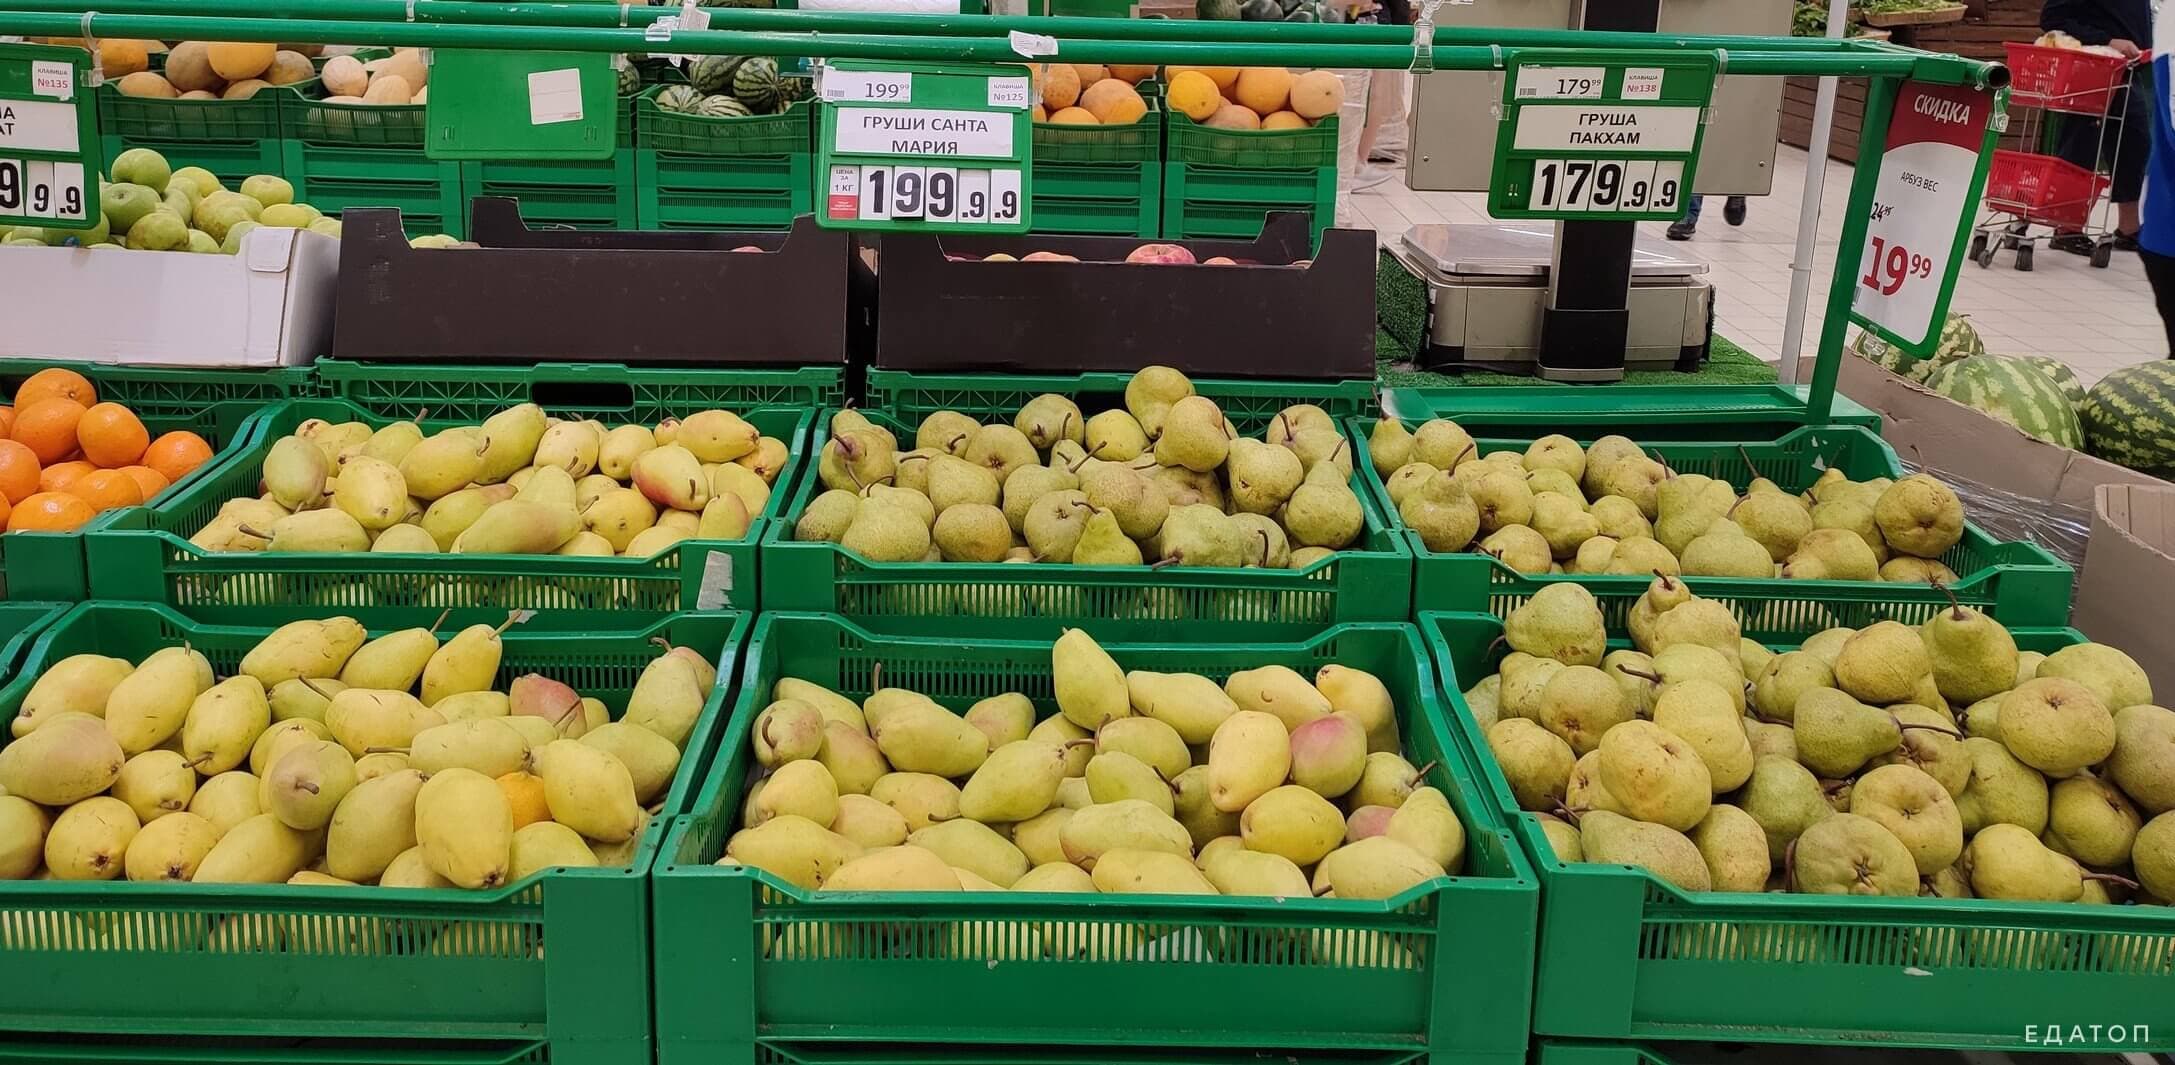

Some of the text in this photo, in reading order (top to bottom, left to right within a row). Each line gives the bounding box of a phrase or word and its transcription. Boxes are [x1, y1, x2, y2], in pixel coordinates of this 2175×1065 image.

[37, 78, 68, 89] №135
[1626, 83, 1657, 93] №138
[993, 93, 1024, 101] №125
[1914, 94, 1970, 125] СКИДКА
[863, 116, 988, 132] ГРУШИ САНТА
[1578, 113, 1637, 126] ГРУША
[1569, 132, 1640, 144] ПАКХАМ
[891, 140, 958, 154] МАРИЯ
[841, 184, 855, 192] КГ
[1900, 171, 1939, 193] АРБУЗ ВЕС
